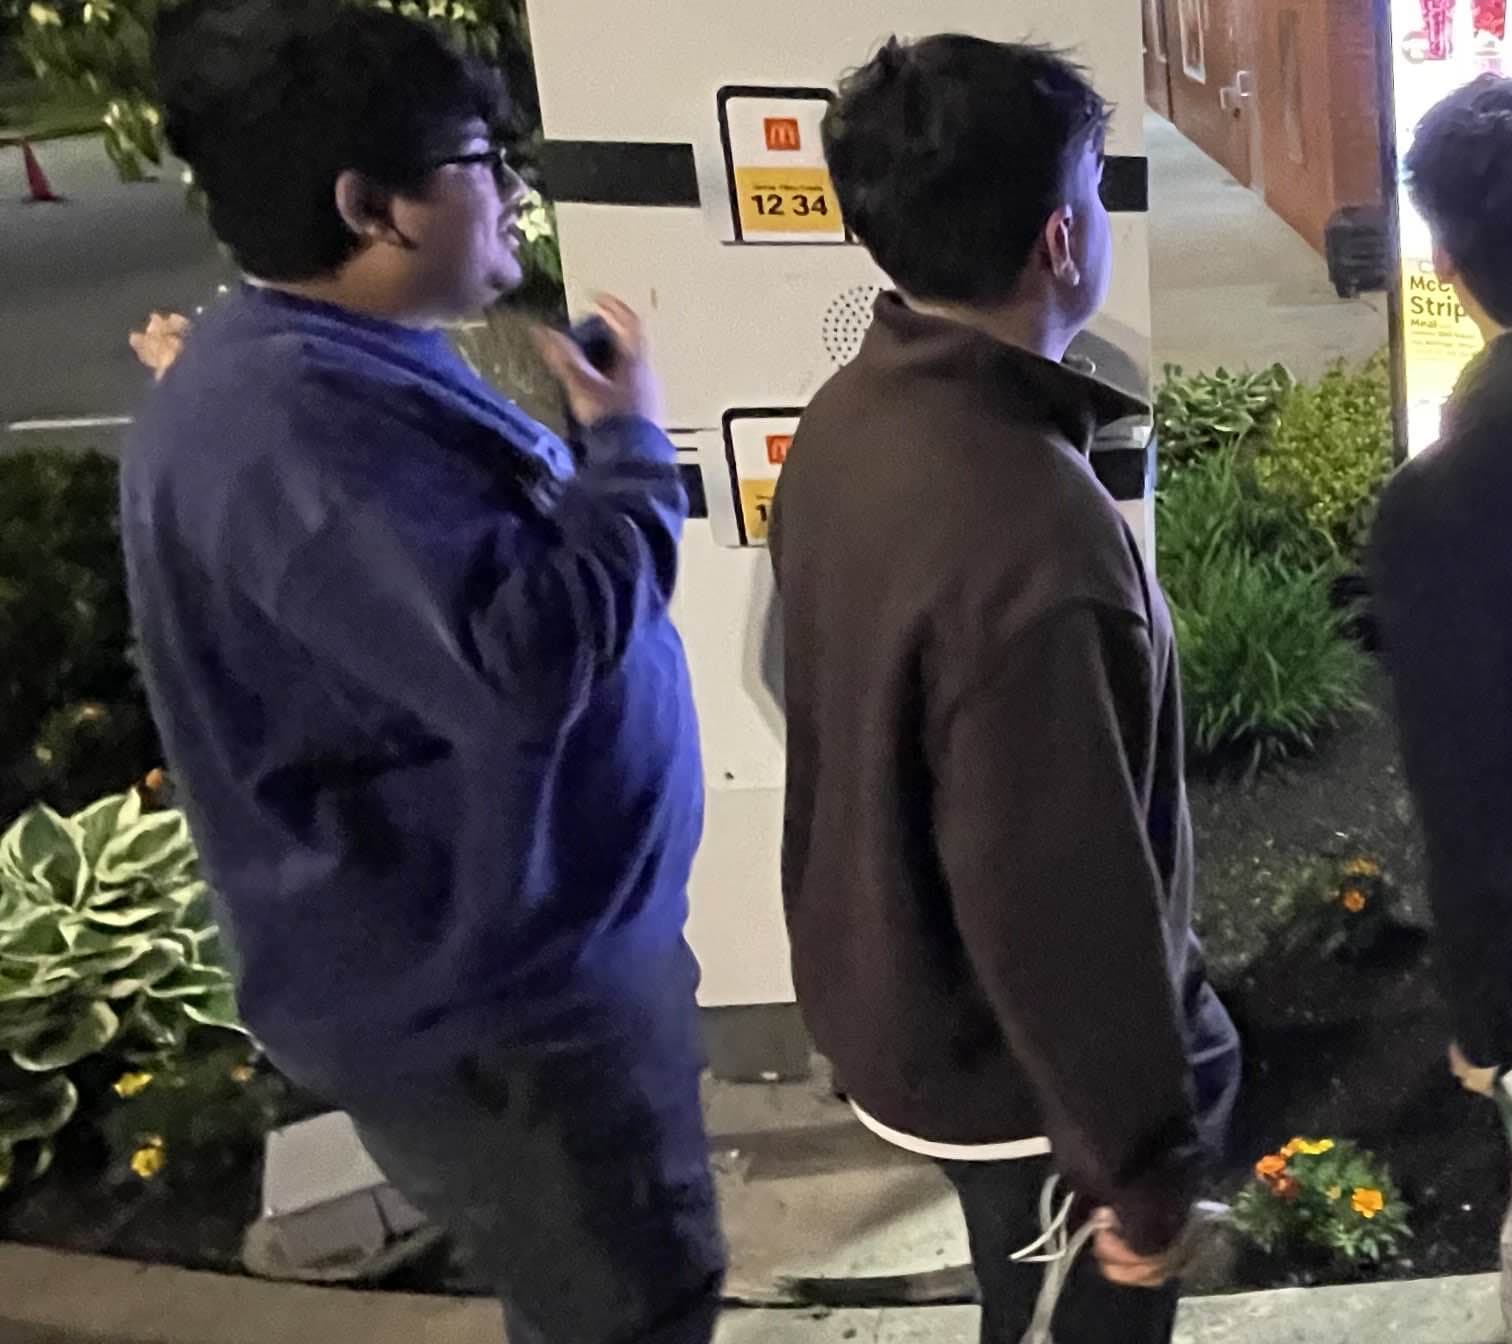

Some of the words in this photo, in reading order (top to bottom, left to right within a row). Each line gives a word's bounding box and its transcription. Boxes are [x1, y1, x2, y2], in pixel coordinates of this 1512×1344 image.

[751, 194, 785, 216] 12
[791, 194, 828, 217] 34
[1410, 295, 1465, 324] Strip
